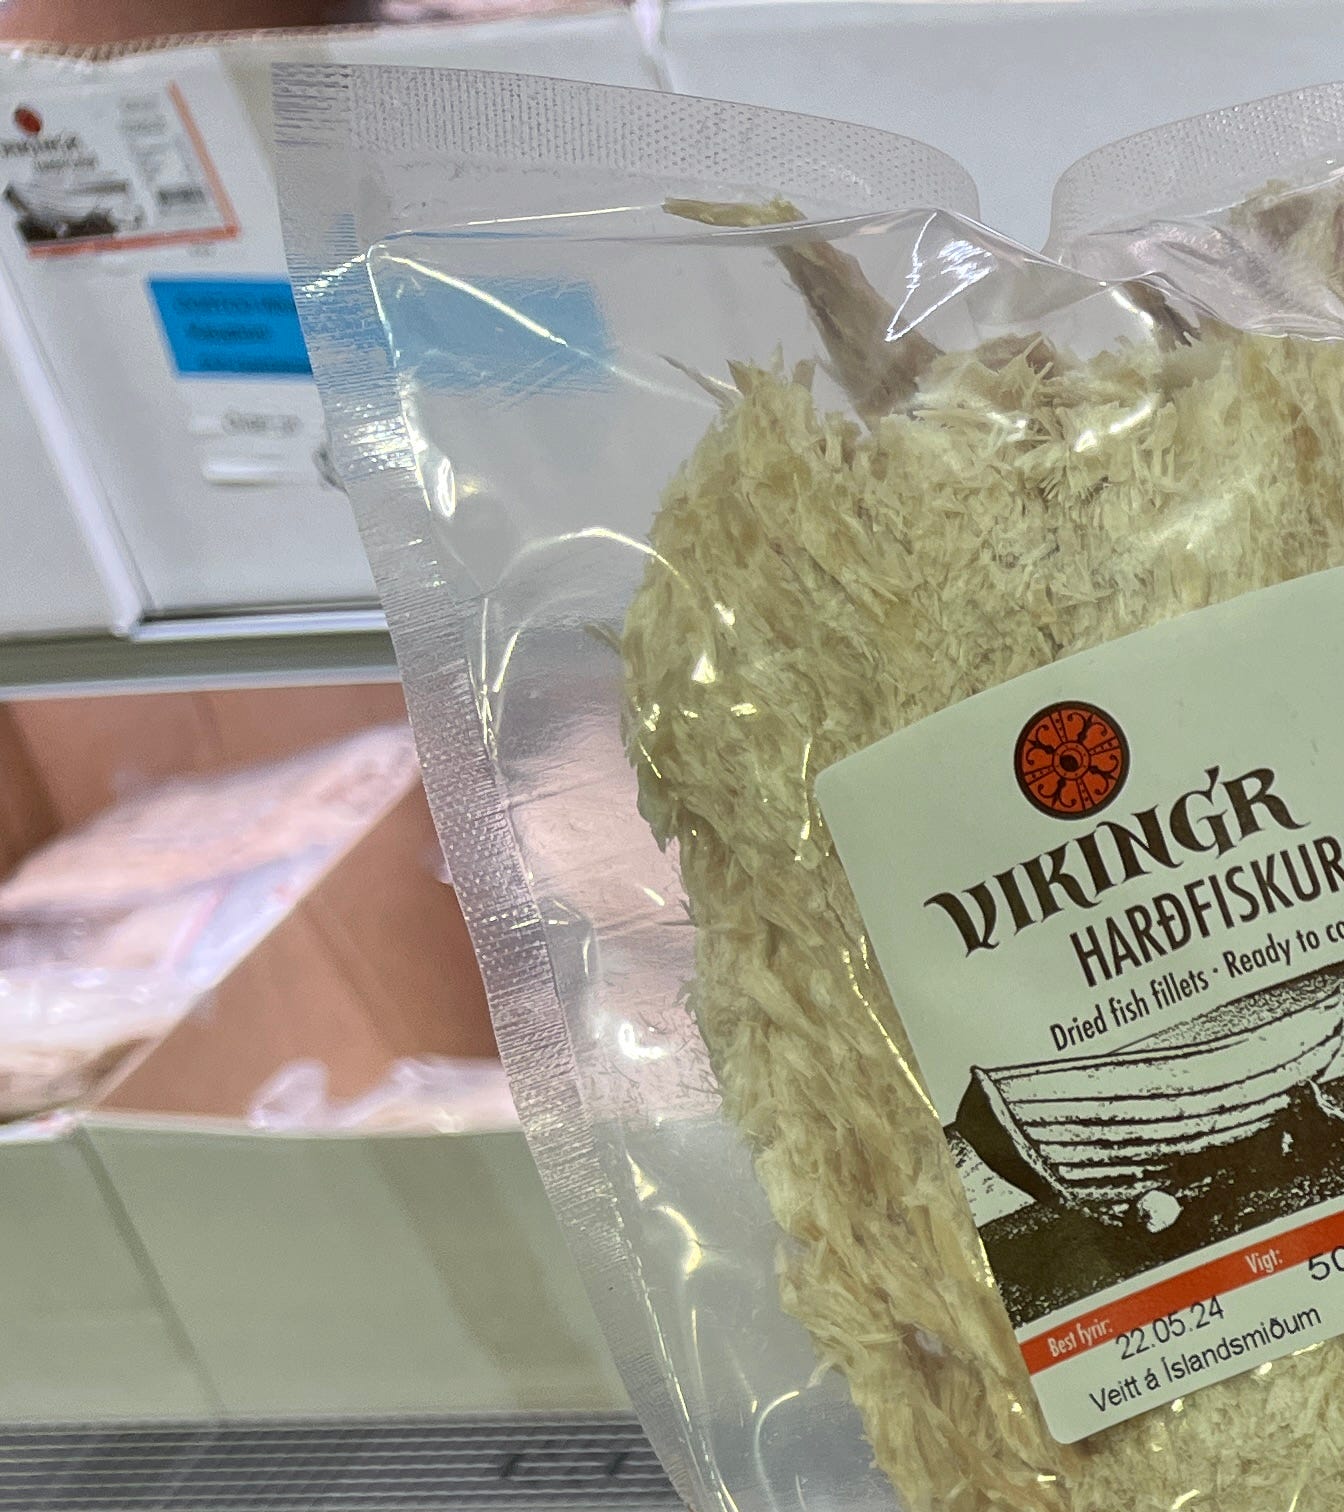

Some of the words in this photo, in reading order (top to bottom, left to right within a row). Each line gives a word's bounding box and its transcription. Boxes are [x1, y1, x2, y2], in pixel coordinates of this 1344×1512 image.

[1050, 1010, 1107, 1052] Dried
[1110, 987, 1150, 1029] fish
[1151, 967, 1210, 1014] fillets
[1222, 932, 1295, 979] Ready
[1297, 928, 1321, 953] to
[1244, 1248, 1284, 1274] Vigt:
[1047, 1332, 1077, 1358] Best
[1077, 1318, 1113, 1350] fyrir:
[1089, 1379, 1144, 1414] Veitt
[1146, 1367, 1162, 1391] á
[1162, 1306, 1322, 1384] Íslandsmiðum
[1115, 1295, 1226, 1361] 22.05.24
